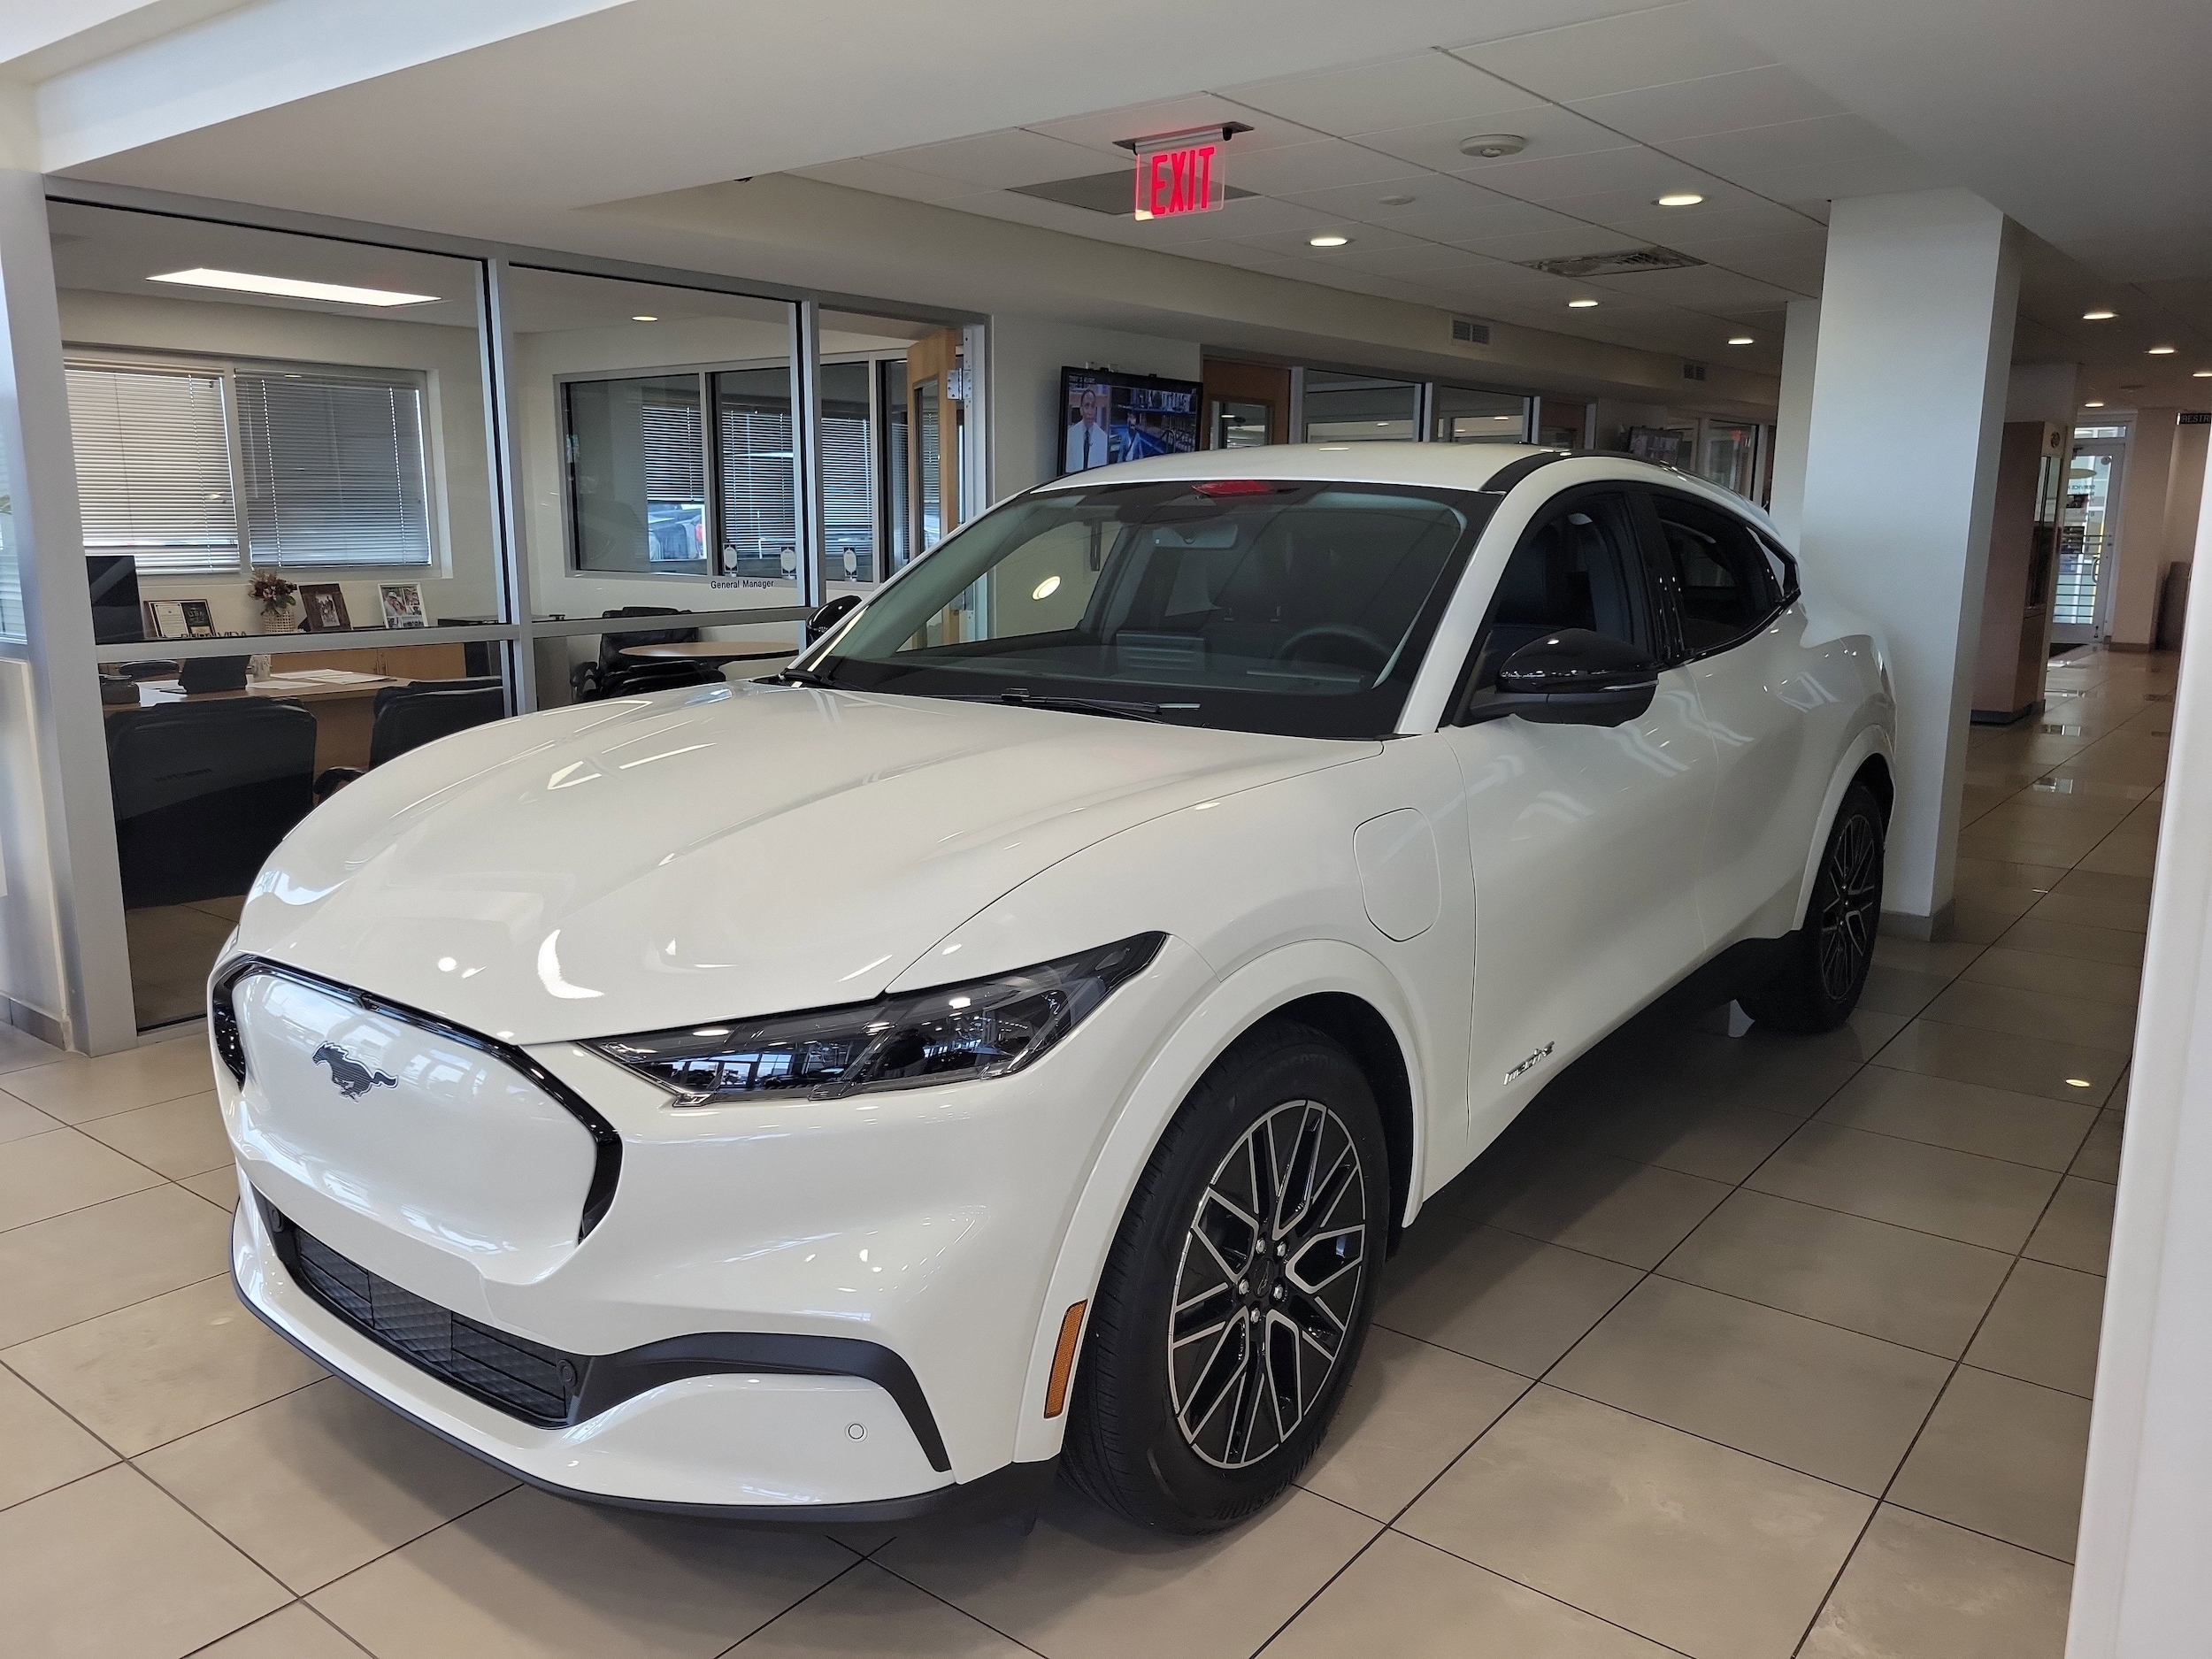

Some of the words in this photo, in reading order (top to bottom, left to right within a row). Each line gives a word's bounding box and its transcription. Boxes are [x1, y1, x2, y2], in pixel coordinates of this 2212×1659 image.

[1150, 147, 1215, 216] EXIT
[2181, 414, 2210, 423] RESTR
[710, 580, 740, 589] General
[742, 580, 774, 589] Manager
